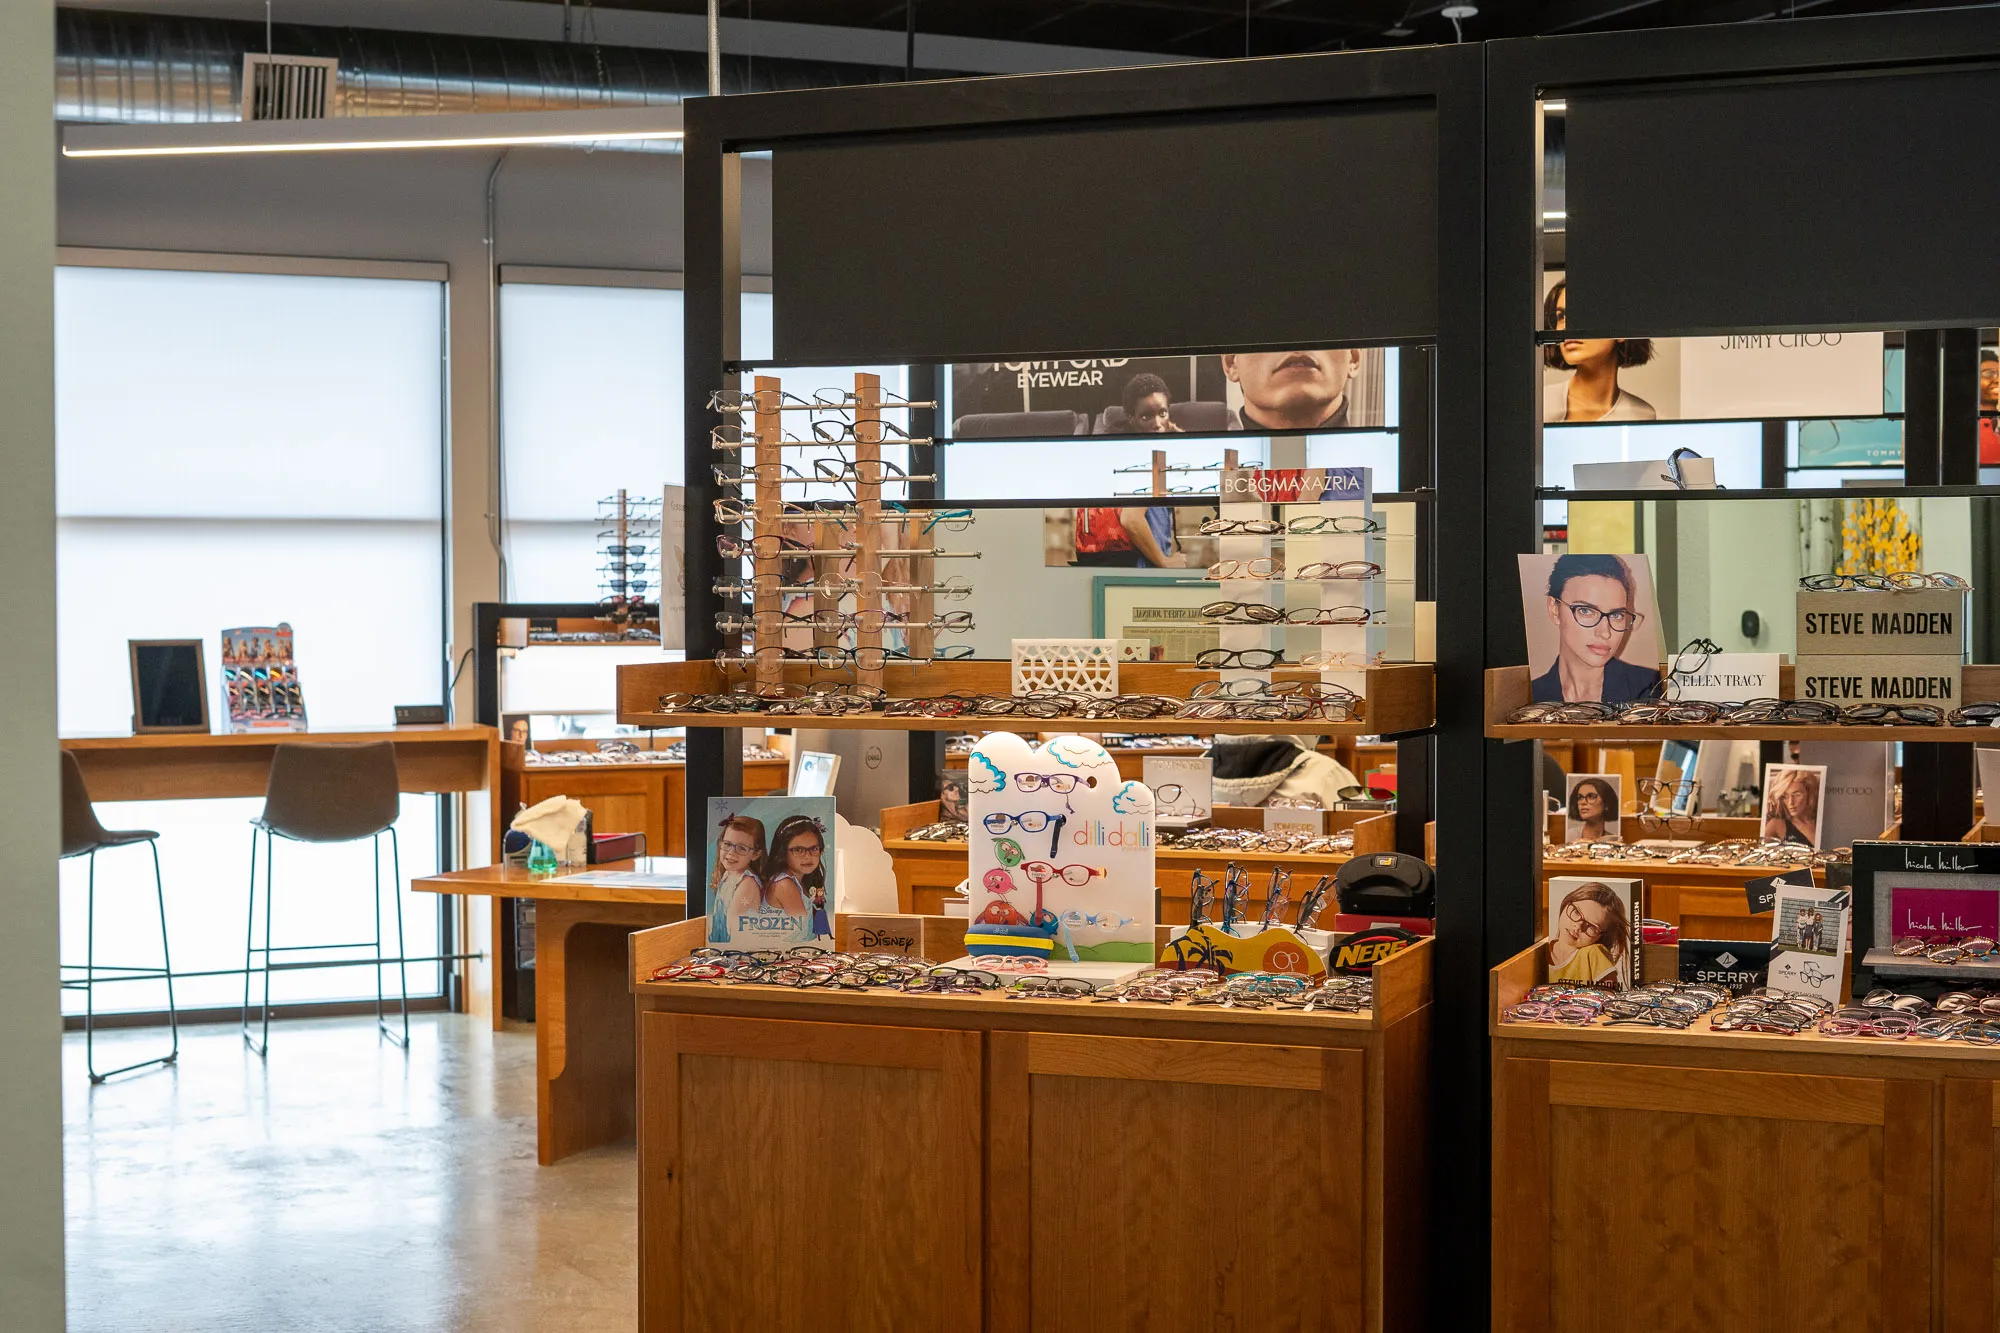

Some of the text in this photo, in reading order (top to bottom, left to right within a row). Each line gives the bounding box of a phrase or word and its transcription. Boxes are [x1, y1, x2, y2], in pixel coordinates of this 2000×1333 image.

[1720, 335, 1771, 350] JIMMY
[1017, 370, 1103, 388] EYEWEAR
[1224, 475, 1361, 493] BCBGMAXAZRIA
[1805, 612, 1953, 635] STEVE MADDEN
[1681, 674, 1764, 687] ELLEN TRACY
[1805, 676, 1952, 699] STEVE MADDEN
[1073, 820, 1150, 847] dilli dalli
[738, 915, 803, 932] FROZEN
[1336, 939, 1408, 968] NERF
[1696, 970, 1759, 983] SPERRY
